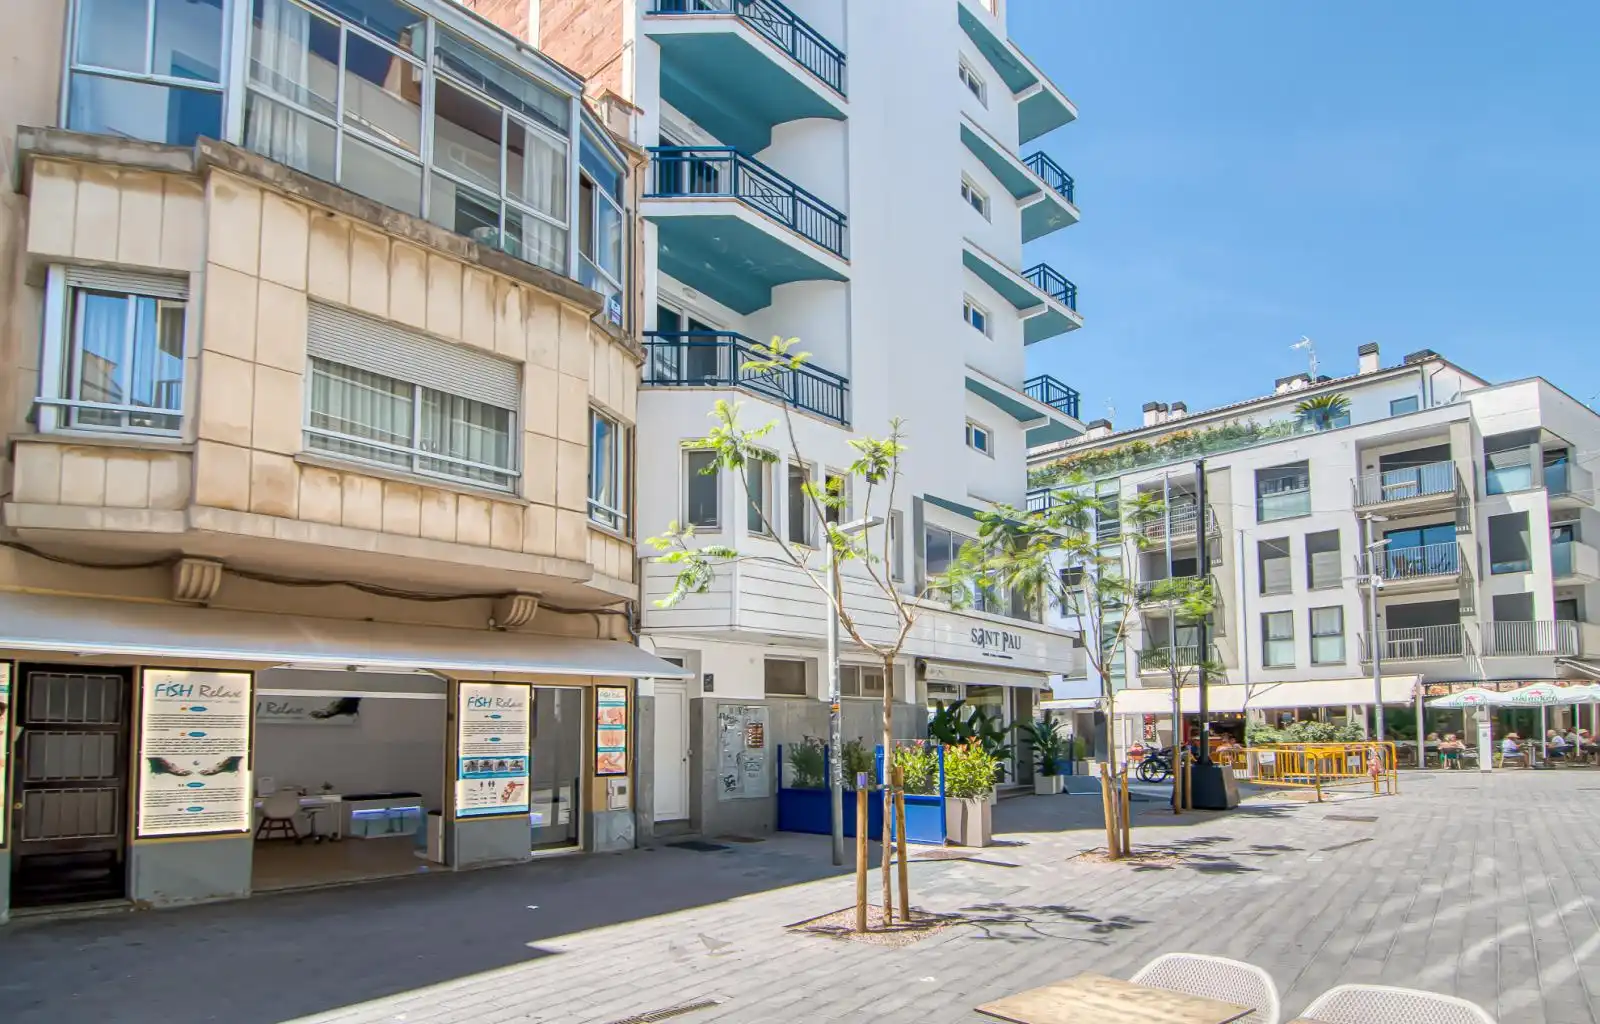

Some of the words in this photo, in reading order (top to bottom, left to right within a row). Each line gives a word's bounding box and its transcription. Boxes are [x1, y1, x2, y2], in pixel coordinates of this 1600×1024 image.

[1002, 631, 1021, 651] PAU
[199, 684, 241, 698] Relax
[266, 701, 304, 714] Relax
